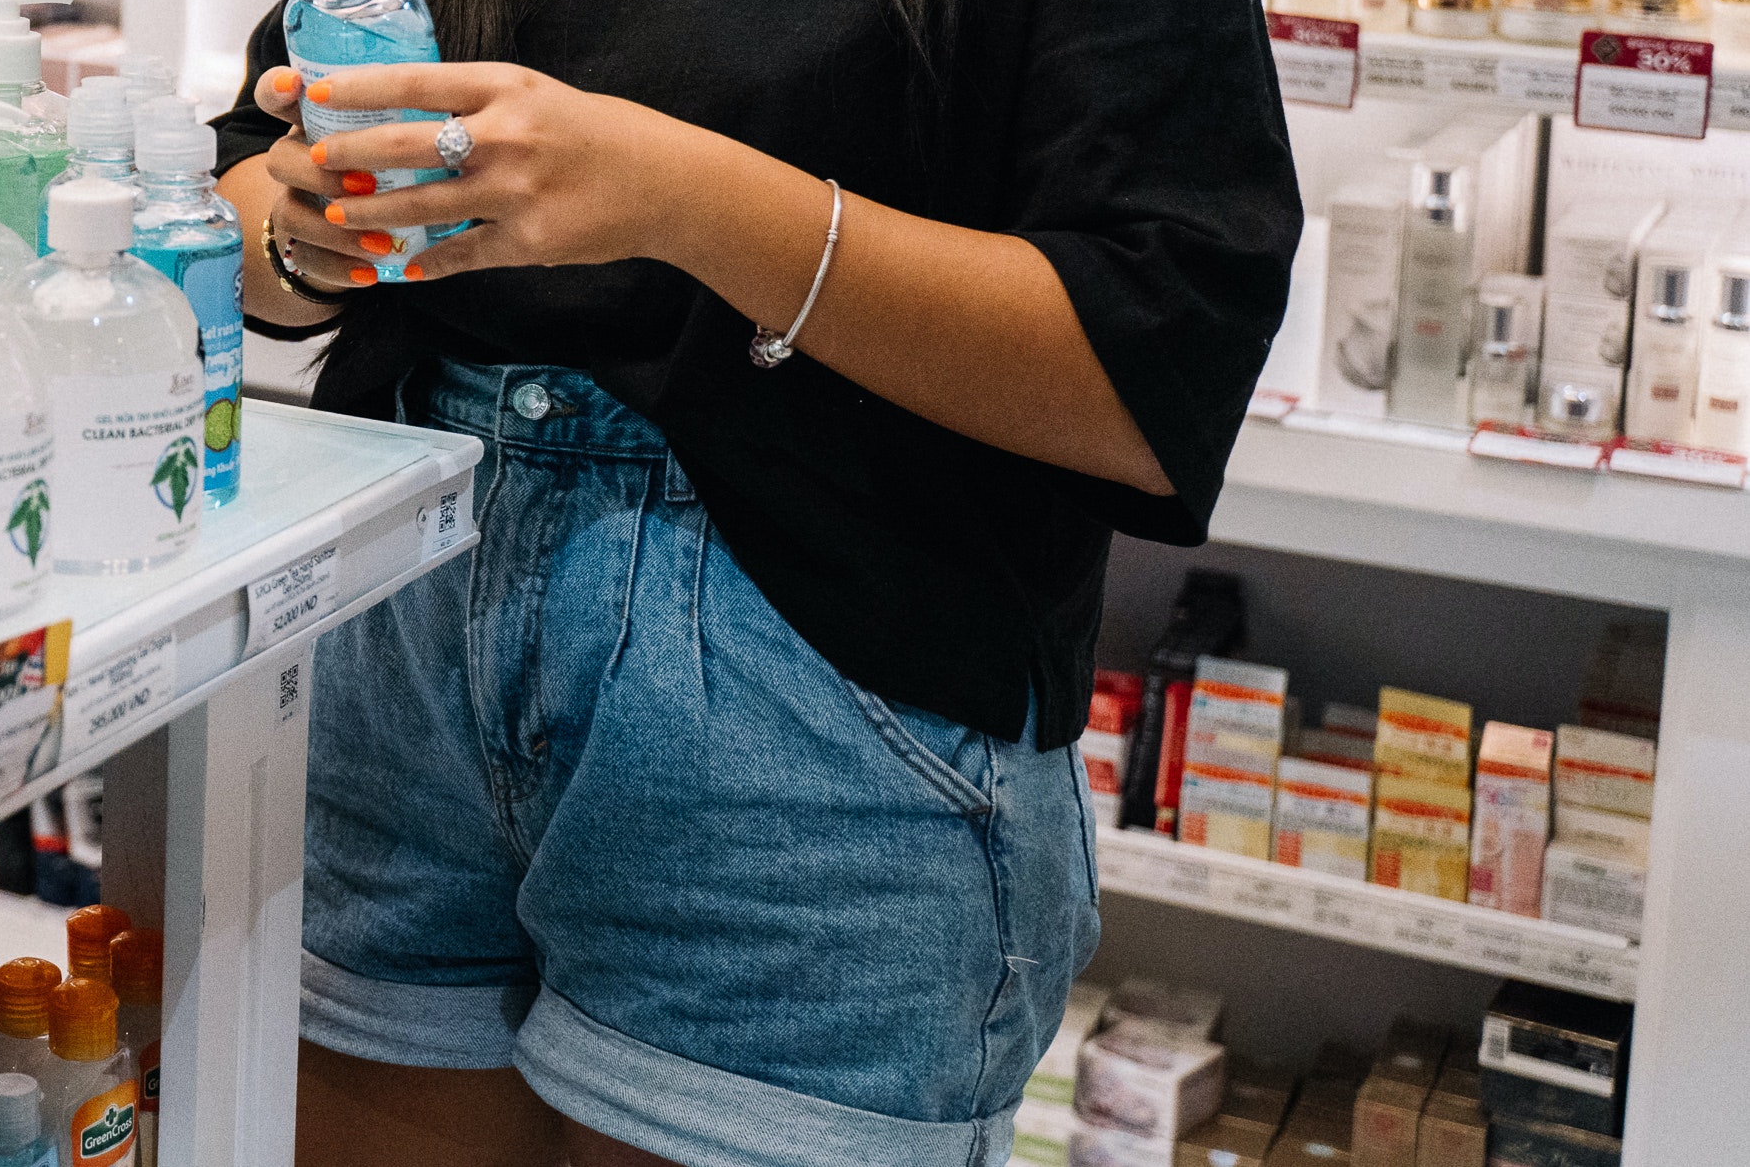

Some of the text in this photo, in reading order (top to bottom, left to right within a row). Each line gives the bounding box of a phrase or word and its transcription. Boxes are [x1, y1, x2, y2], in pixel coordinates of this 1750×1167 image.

[1637, 49, 1692, 74] 30%
[82, 427, 126, 441] CLEAN
[129, 418, 184, 439] BACTERIAL
[300, 594, 318, 615] VND
[129, 687, 150, 711] VND
[84, 1116, 133, 1150] GreenCross
